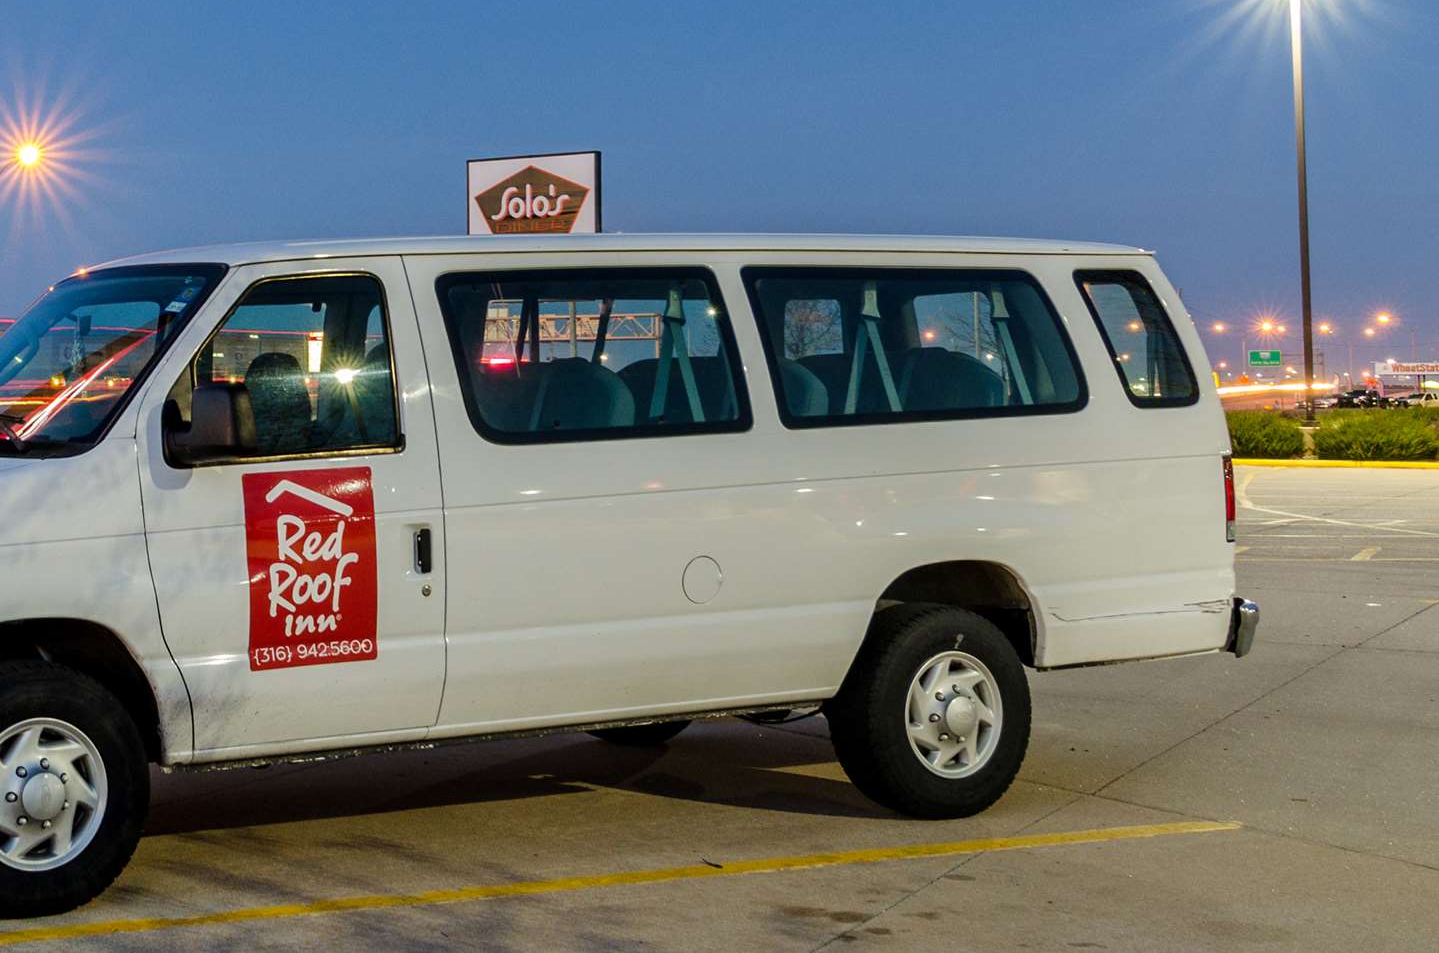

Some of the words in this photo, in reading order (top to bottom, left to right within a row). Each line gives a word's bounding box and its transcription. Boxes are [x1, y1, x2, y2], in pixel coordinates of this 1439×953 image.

[491, 183, 571, 221] Solo's
[277, 514, 345, 564] Red
[268, 552, 359, 618] Roof
